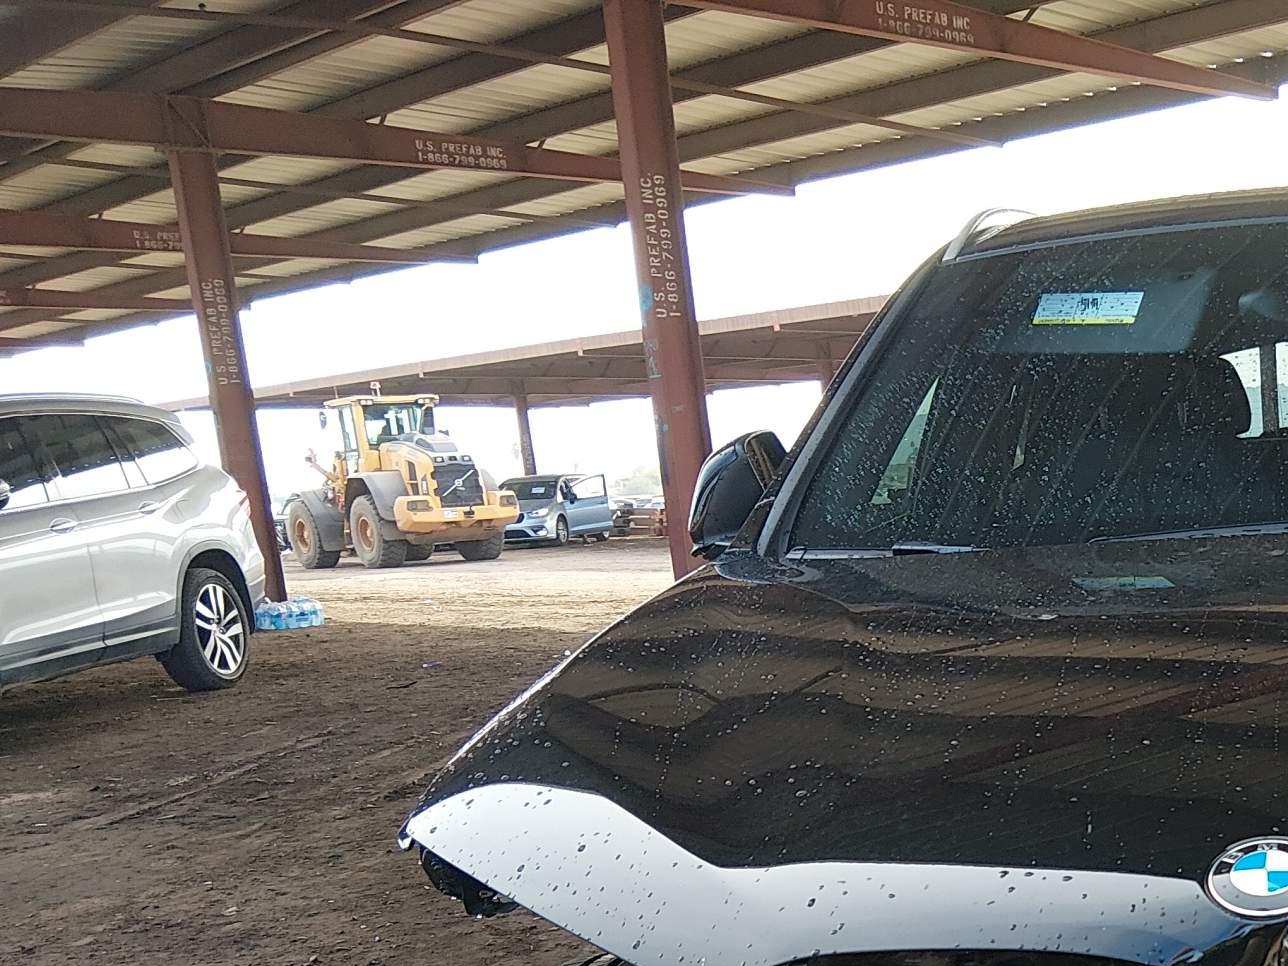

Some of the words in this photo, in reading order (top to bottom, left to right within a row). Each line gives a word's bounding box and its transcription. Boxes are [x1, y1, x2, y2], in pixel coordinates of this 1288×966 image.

[875, 1, 899, 18] U.S.
[903, 6, 948, 26] PREFAB
[415, 140, 437, 152] U.S.
[441, 142, 483, 156] PREFAB
[486, 146, 507, 159] INC.
[418, 151, 508, 169] 1-866-799-0969
[640, 172, 653, 204] INC.
[644, 213, 662, 277] PREFAB
[653, 174, 682, 317] 1-866-799-0969
[653, 286, 668, 318] U.S.
[206, 308, 224, 355] PREFAB
